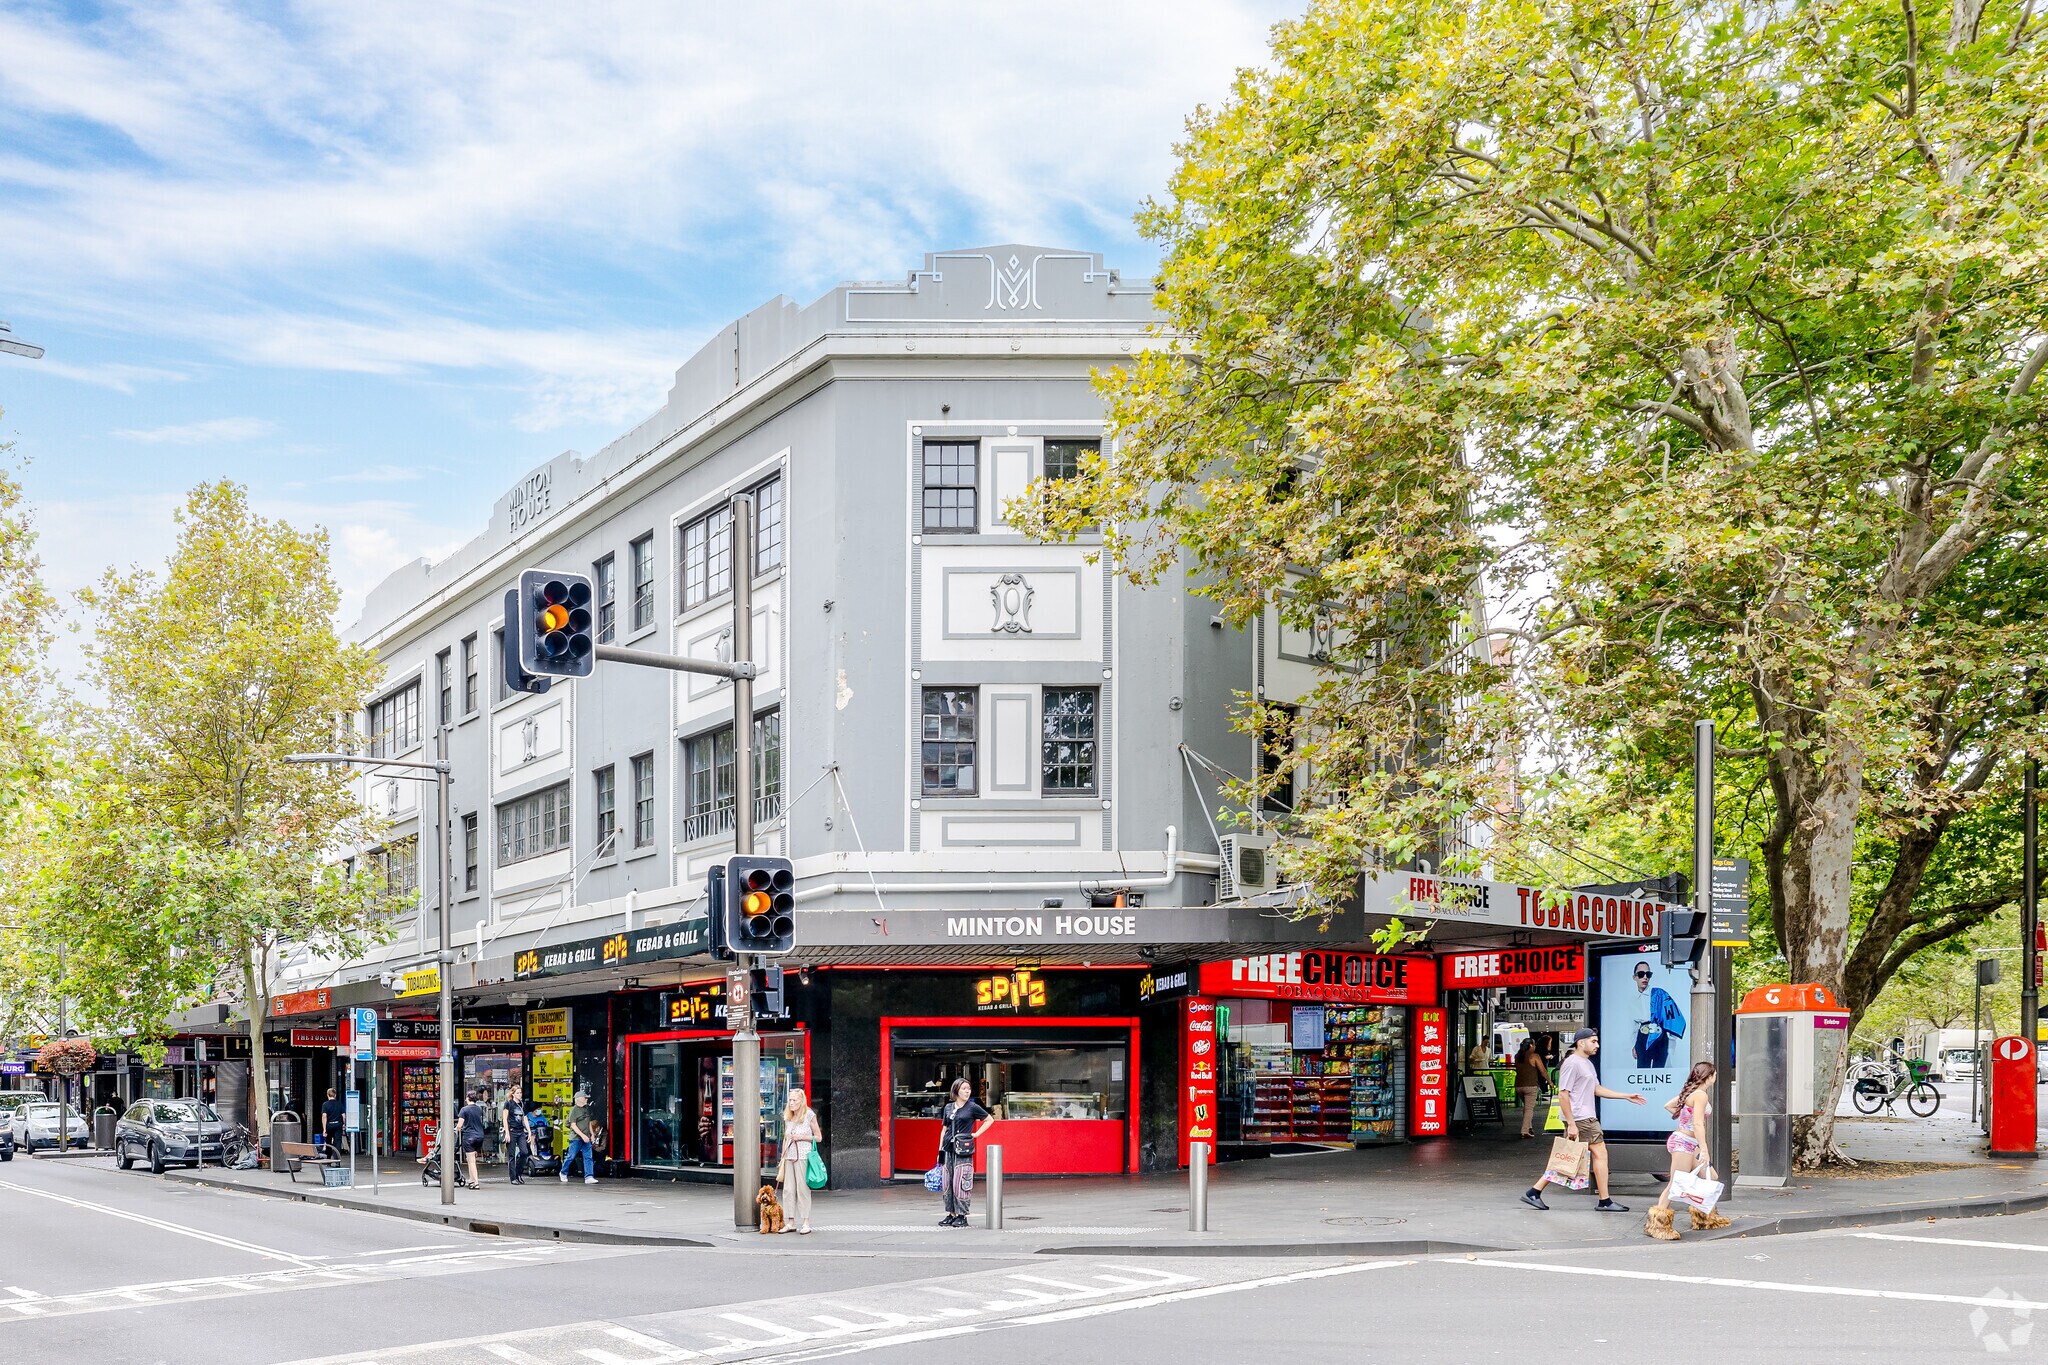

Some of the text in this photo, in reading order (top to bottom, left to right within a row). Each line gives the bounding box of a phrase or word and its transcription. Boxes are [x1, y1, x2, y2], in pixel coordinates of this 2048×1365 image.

[508, 464, 552, 513] MINTON
[509, 488, 551, 534] HOUSE
[1409, 877, 1490, 909] FREEOICE
[1516, 887, 1666, 938] TOBACCONIST
[947, 916, 1136, 937] MINTON HOUSE
[635, 935, 663, 954] KEBAB
[664, 934, 671, 948] &
[672, 929, 698, 948] GRILL
[544, 952, 567, 968] KEBAB
[567, 951, 573, 964] &
[574, 947, 596, 963] GRILL
[407, 973, 439, 993] TOBACCONIS
[1155, 975, 1170, 992] KEBAB
[1174, 971, 1187, 988] GRILL
[1482, 974, 1548, 986] TOBACCONIST
[977, 971, 1046, 1008] SPITZ
[1275, 984, 1372, 1001] TOBACCONIST
[671, 996, 710, 1020] SPITZ
[1197, 1003, 1215, 1012] pepsi
[537, 1011, 566, 1024] TOBACCONIST
[1520, 1012, 1583, 1021] italian eater
[475, 1030, 514, 1041] VAPERY
[537, 1025, 555, 1035] VAPERY
[402, 1048, 431, 1056] station
[1425, 1060, 1439, 1068] RAW
[1190, 1071, 1213, 1080] Red Bull
[1627, 1074, 1672, 1085] CELINE
[1420, 1088, 1441, 1097] SMOK
[1421, 1121, 1441, 1131] zippo
[1554, 1151, 1577, 1164] coles
